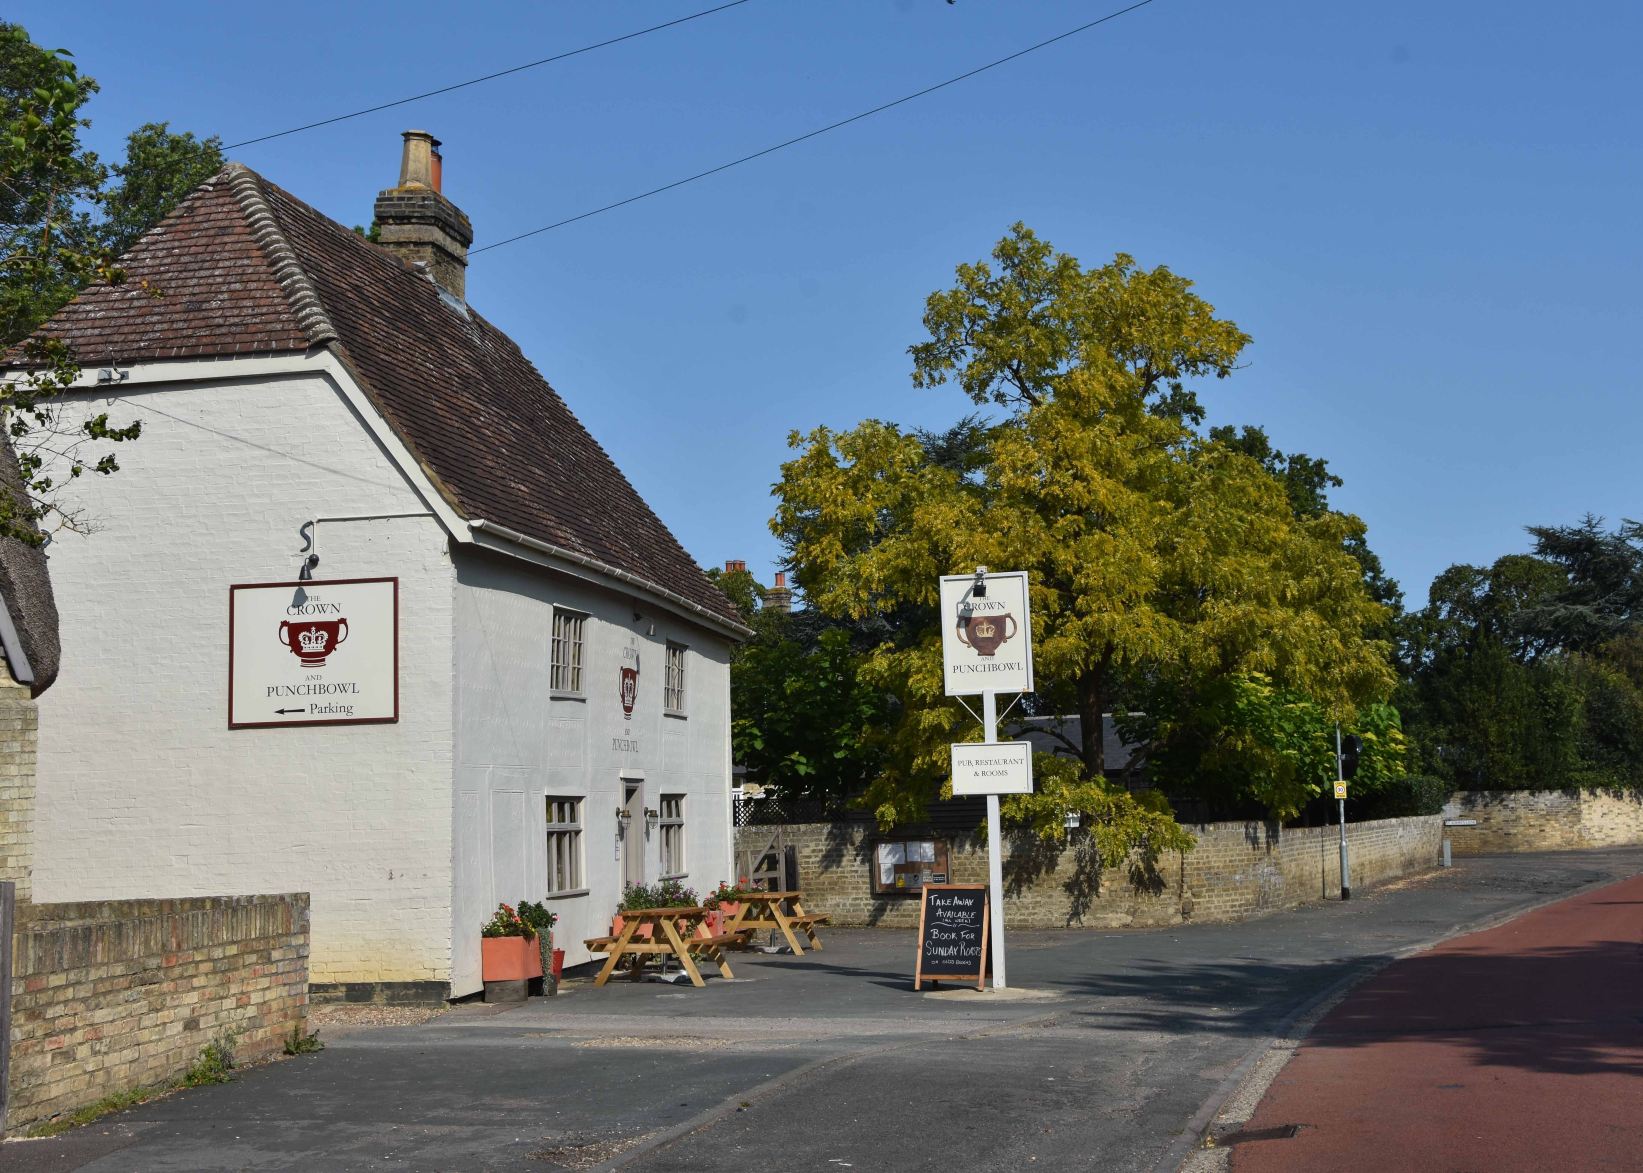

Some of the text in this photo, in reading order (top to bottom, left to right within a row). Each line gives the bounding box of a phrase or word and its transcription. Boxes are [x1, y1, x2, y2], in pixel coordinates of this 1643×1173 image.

[286, 602, 343, 616] CROWN
[963, 601, 1007, 612] CROWN
[952, 662, 1024, 674] PUNCHBOWL
[305, 674, 323, 682] AND
[266, 682, 360, 697] PUNCHBOWL
[310, 702, 355, 716] Parking
[975, 758, 1025, 766] RESTAURANT
[928, 894, 974, 906] TAKE AWAY
[935, 907, 976, 919] AVAILABLE
[930, 928, 975, 940] BOOK FOR
[925, 940, 958, 957] SUNDAY
